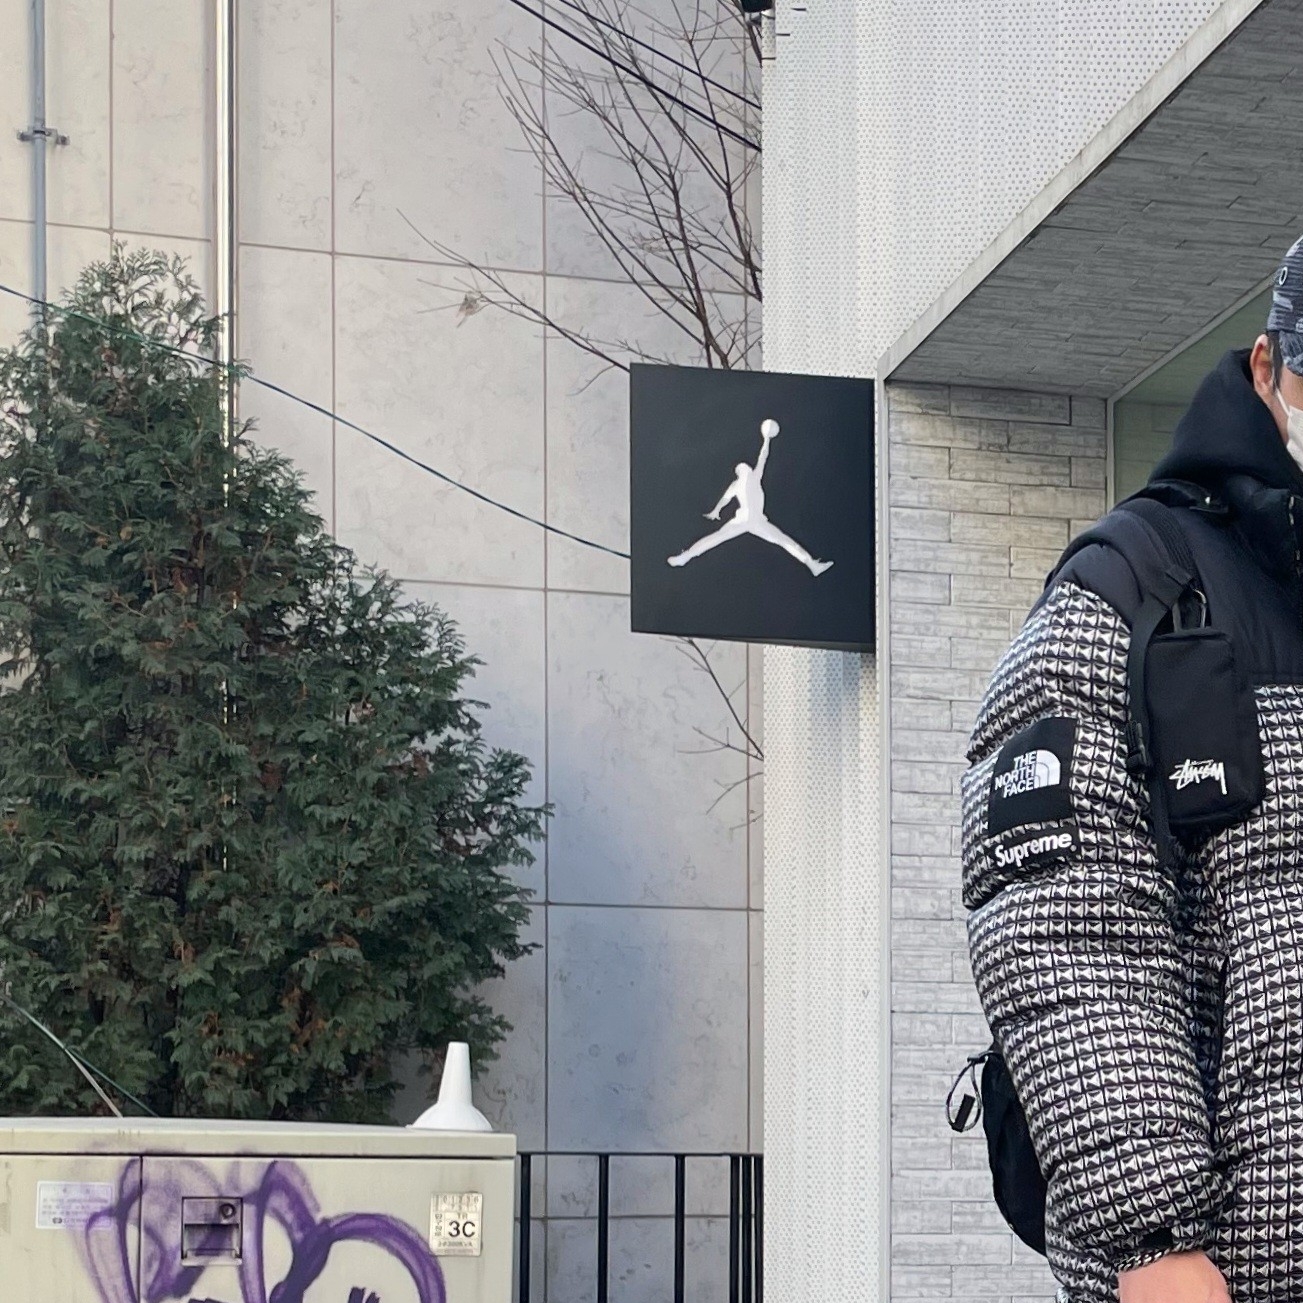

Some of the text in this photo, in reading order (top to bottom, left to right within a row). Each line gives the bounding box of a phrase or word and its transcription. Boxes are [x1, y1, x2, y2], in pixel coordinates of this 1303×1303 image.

[1014, 751, 1036, 770] THE
[995, 763, 1035, 790] NORTH
[1003, 777, 1034, 798] FACE
[995, 833, 1072, 867] Supreme
[448, 1221, 475, 1237] 3C
